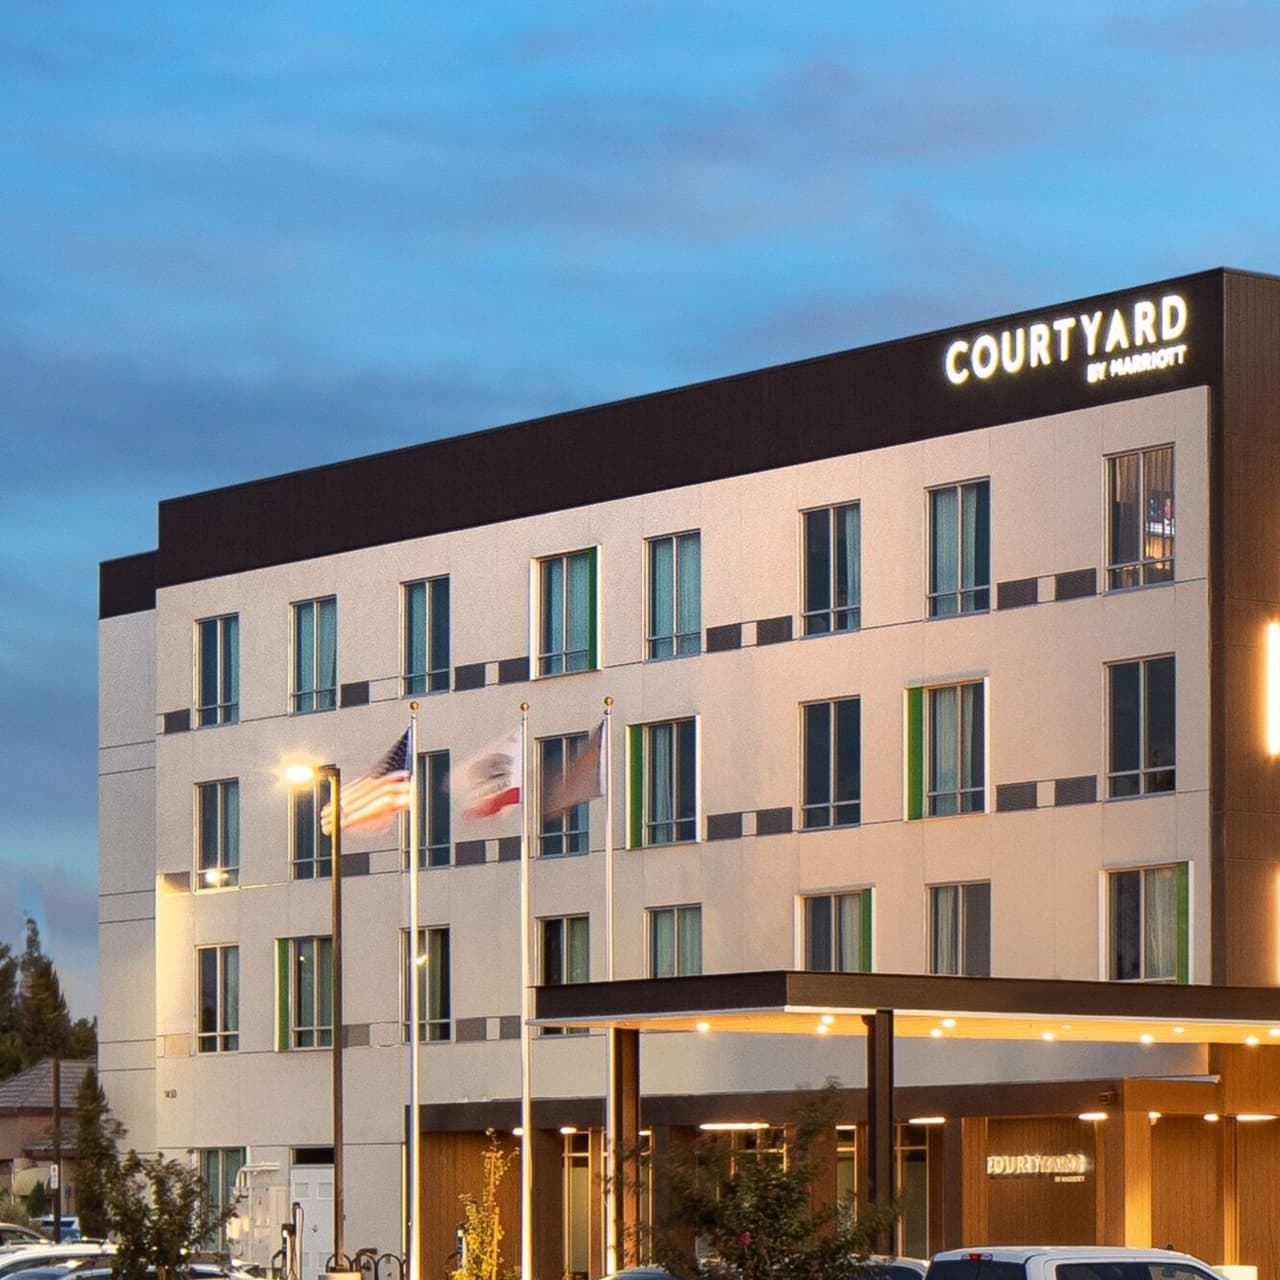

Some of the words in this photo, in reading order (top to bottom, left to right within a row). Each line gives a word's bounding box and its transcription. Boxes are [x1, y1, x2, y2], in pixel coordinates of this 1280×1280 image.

[944, 294, 1188, 385] COURTYARD
[1087, 361, 1108, 383] BY
[1110, 344, 1188, 378] MARRIOTT
